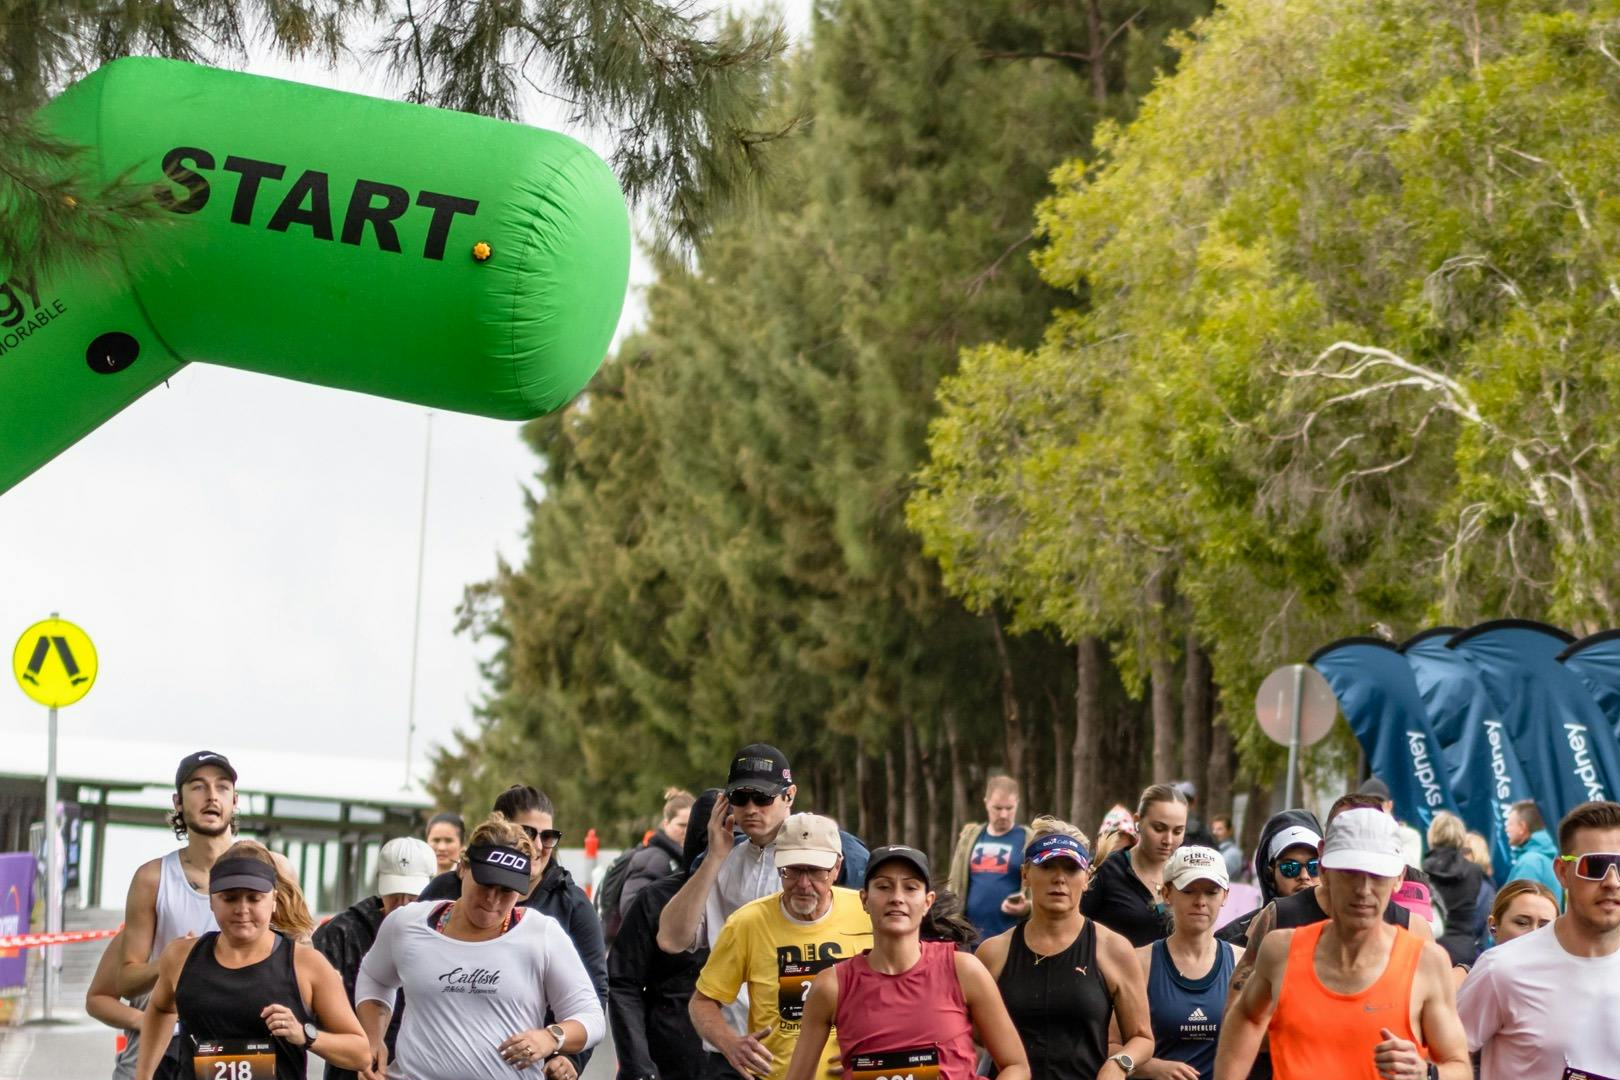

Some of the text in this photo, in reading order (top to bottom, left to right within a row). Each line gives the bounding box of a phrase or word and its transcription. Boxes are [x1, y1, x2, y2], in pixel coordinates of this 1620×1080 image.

[156, 146, 480, 261] START
[1406, 730, 1443, 807] sydney
[1483, 719, 1512, 800] sydney
